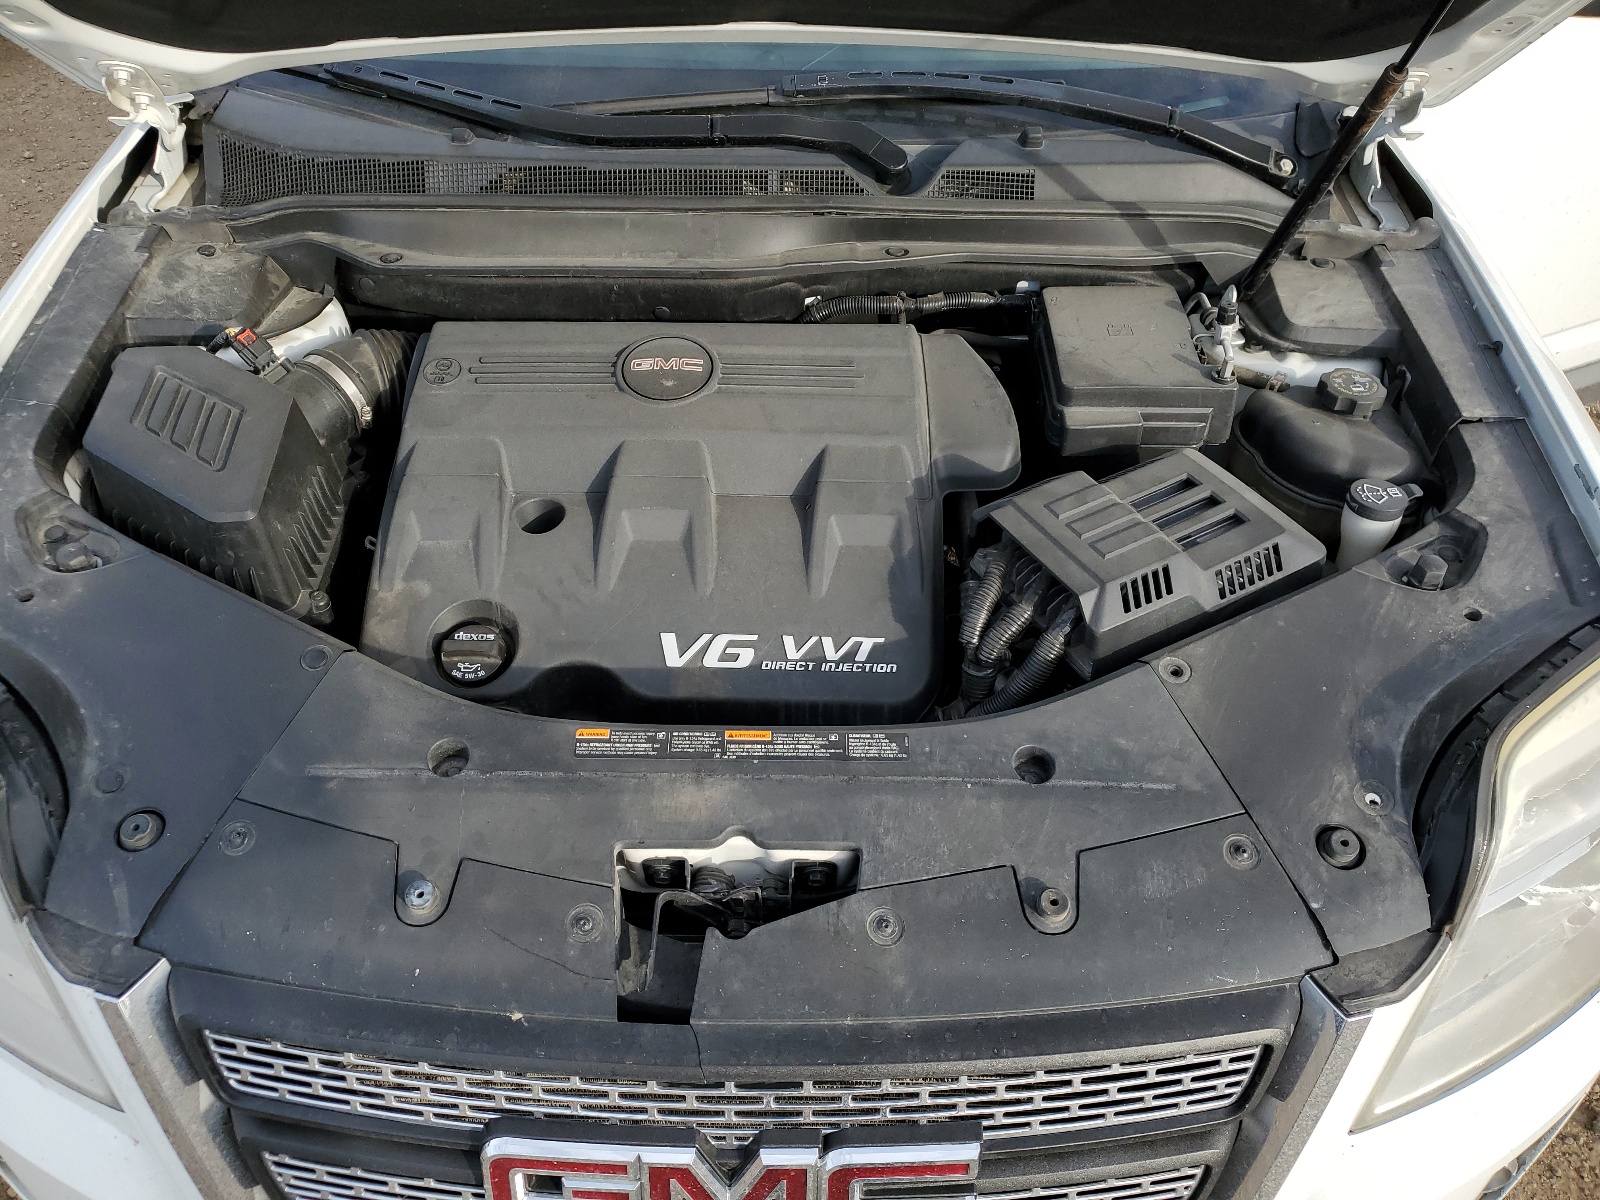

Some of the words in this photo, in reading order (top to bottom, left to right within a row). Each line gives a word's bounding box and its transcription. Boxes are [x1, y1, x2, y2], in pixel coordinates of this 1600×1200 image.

[630, 357, 704, 372] GMC
[454, 631, 496, 641] dexos
[659, 632, 759, 669] V6
[782, 634, 886, 662] VVT
[761, 660, 816, 672] DIRECT
[820, 661, 898, 673] INJECTION
[451, 669, 464, 679] SAE
[464, 670, 486, 679] 5W-30
